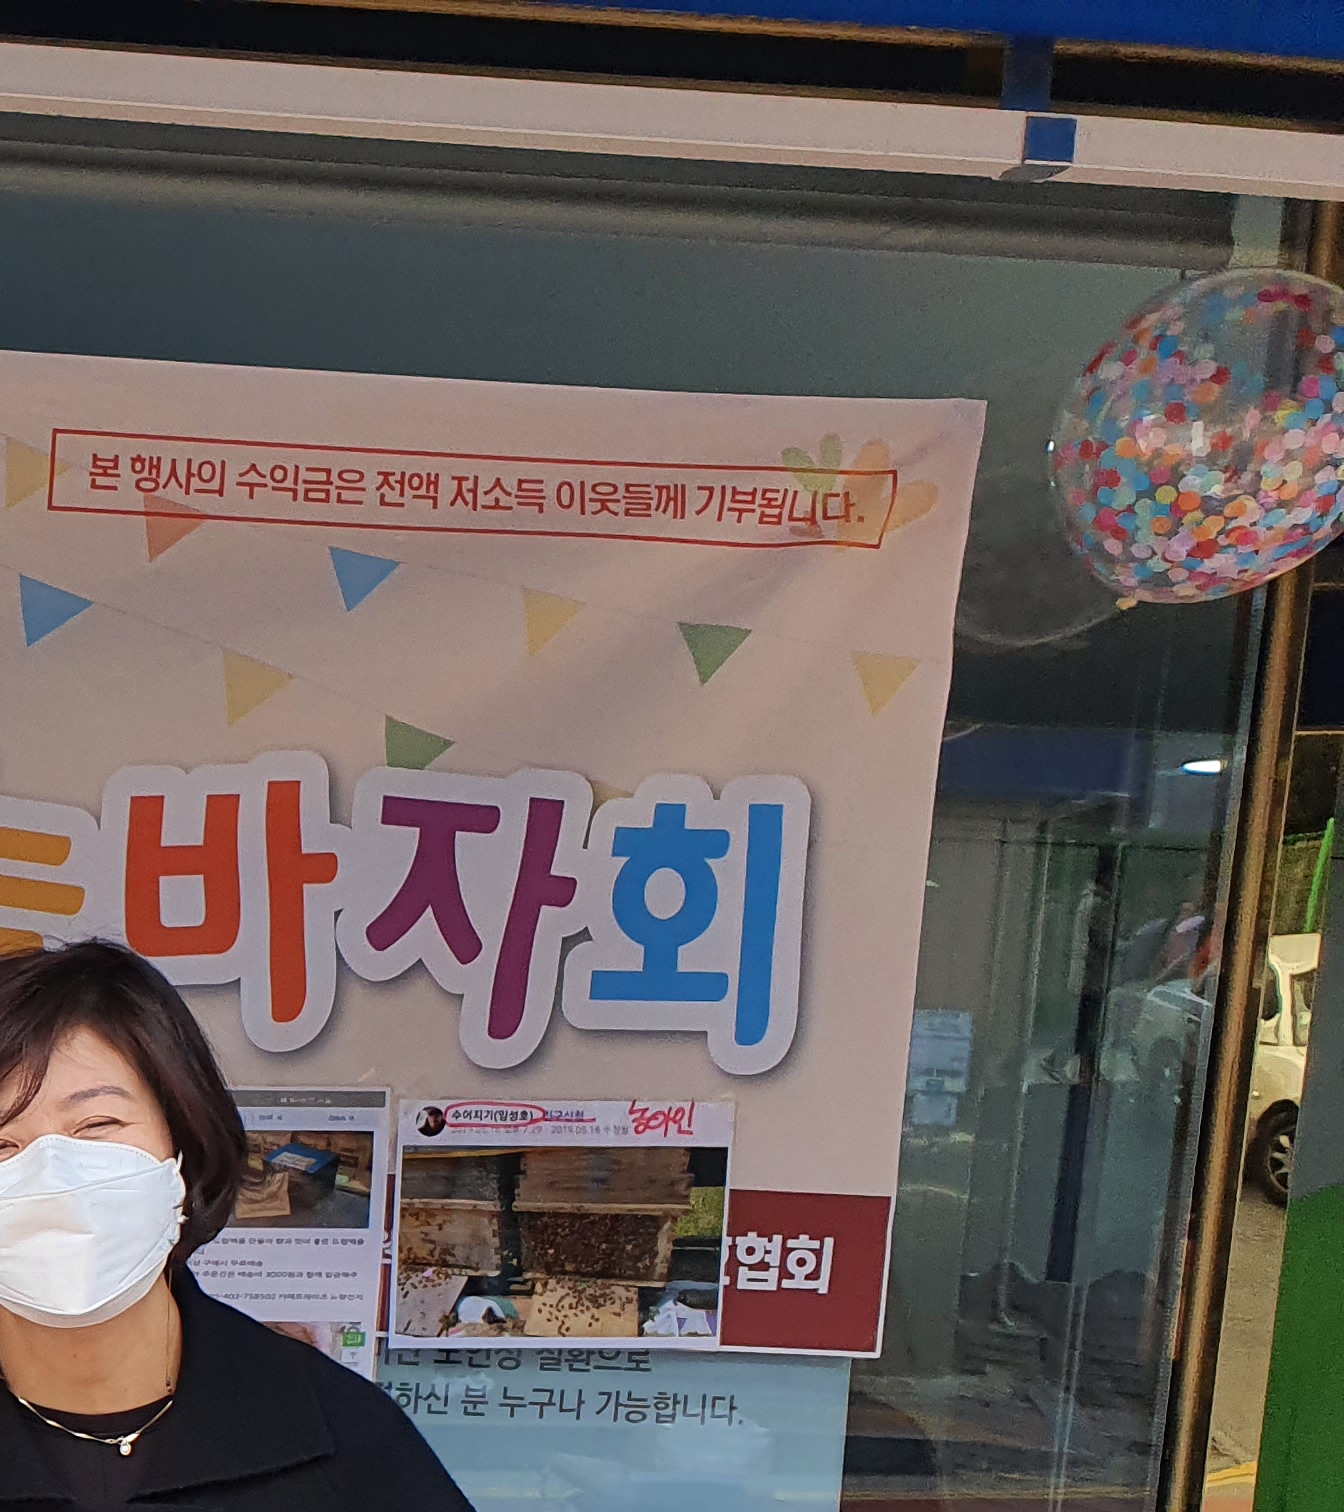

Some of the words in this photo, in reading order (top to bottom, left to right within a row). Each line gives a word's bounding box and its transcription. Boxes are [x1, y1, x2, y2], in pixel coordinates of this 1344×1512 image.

[86, 453, 121, 491] 본
[128, 453, 227, 501] 행사의
[235, 459, 369, 505] 수익금은
[375, 470, 443, 510] 전액
[448, 473, 547, 515] 저소득
[555, 477, 687, 522] 이웃들께
[693, 482, 866, 528] 기부됩니다.
[723, 1231, 834, 1294] 협회
[462, 1384, 486, 1417] 분
[499, 1385, 584, 1421] 누구나
[596, 1388, 744, 1428] 가능합니다.
